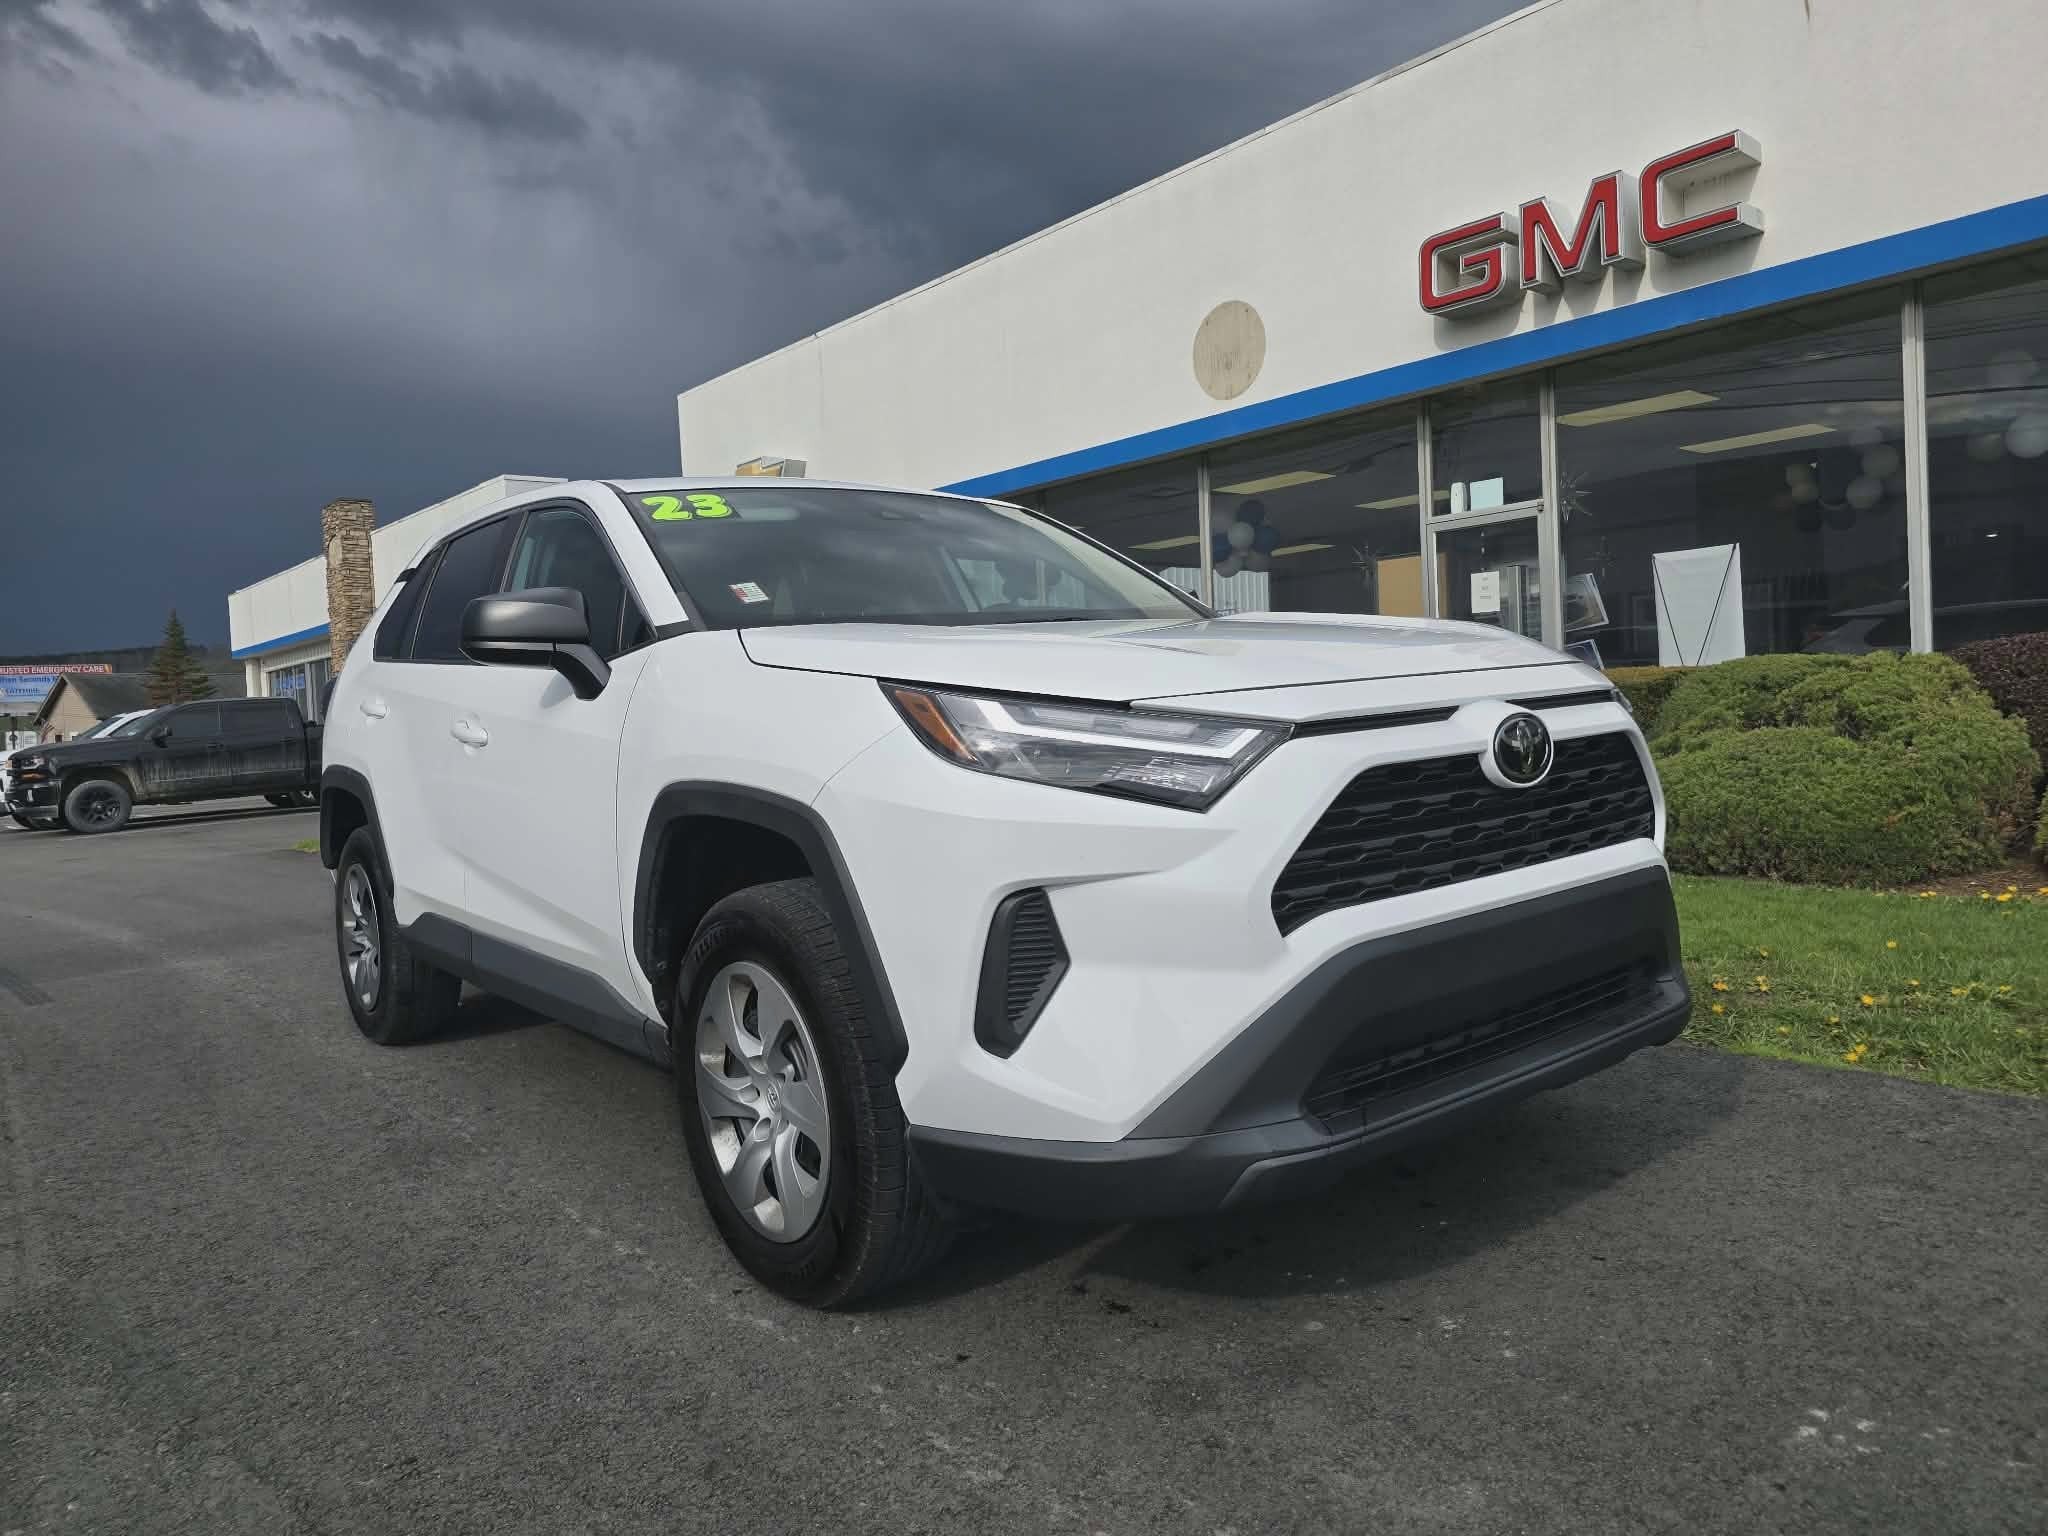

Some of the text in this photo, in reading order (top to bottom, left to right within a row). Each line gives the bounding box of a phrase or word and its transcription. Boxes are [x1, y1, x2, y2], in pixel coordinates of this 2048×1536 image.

[1419, 129, 1763, 316] GMC
[641, 494, 733, 521] 23
[31, 665, 81, 674] EMERGENCY
[83, 664, 105, 673] CARE
